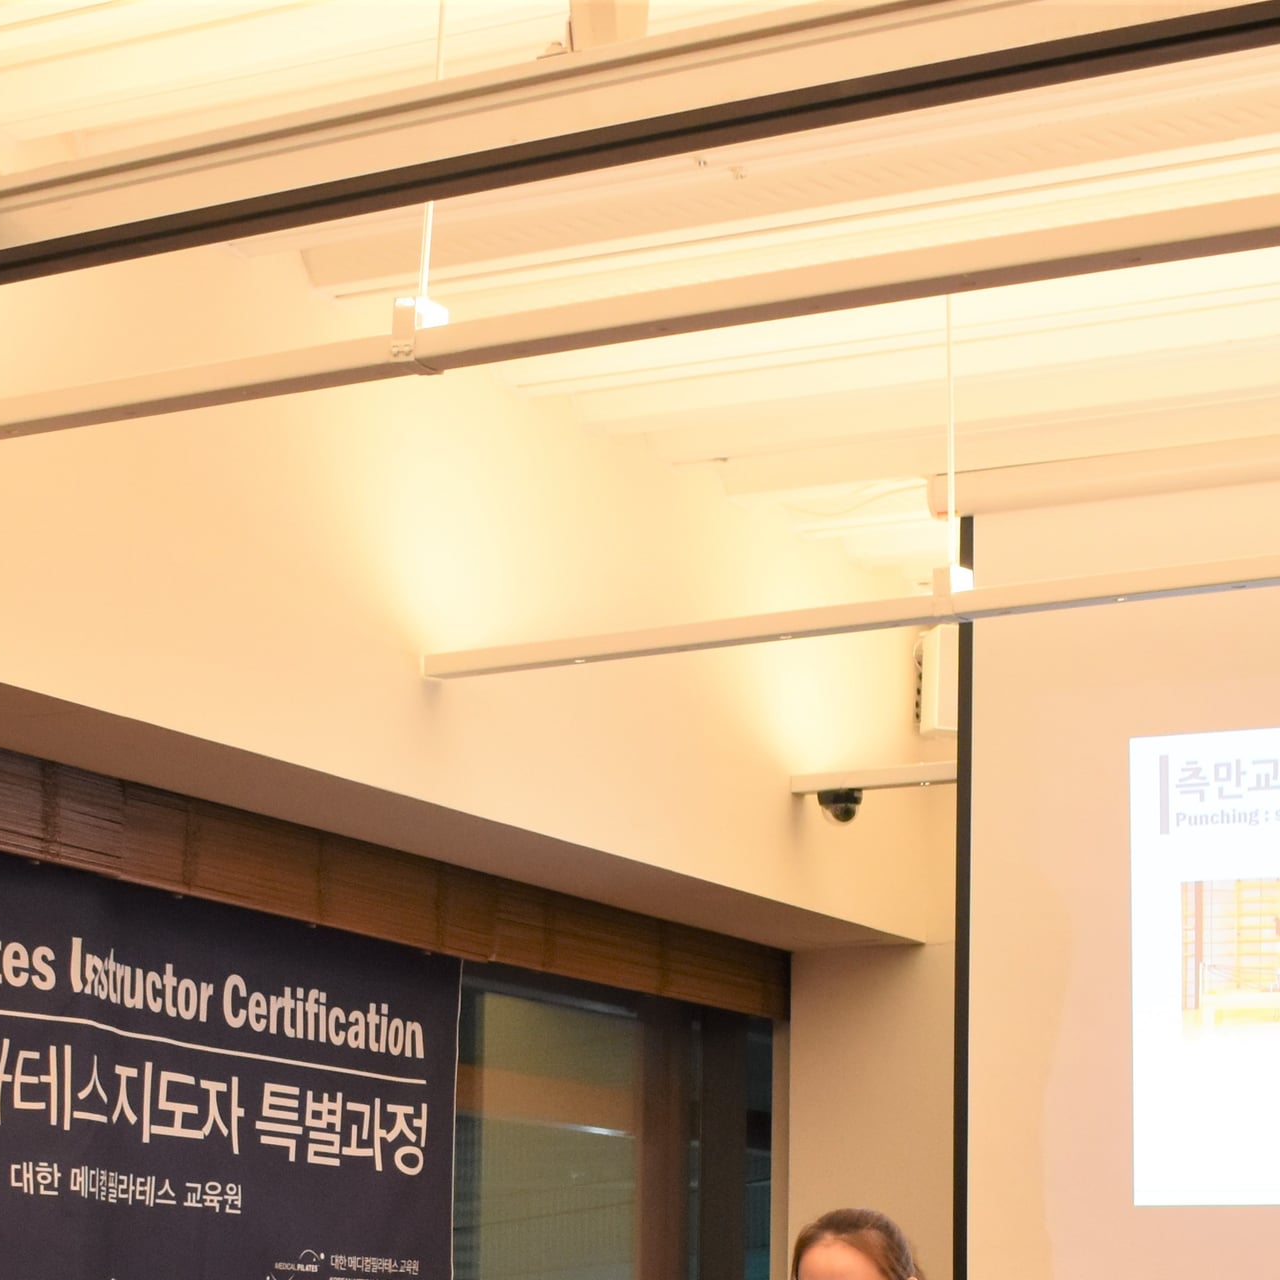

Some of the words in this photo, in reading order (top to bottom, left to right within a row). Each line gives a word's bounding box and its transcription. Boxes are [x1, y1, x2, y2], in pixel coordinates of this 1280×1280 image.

[1175, 809, 1260, 827] Punching
[223, 974, 425, 1059] Certification
[255, 1082, 428, 1176] 특별과정
[10, 1161, 62, 1196] 대한
[70, 1165, 177, 1207] 메디컬필라테스
[183, 1181, 242, 1214] 교육원
[274, 1262, 297, 1271] MEDICAL
[297, 1263, 318, 1272] PILATES
[330, 1255, 347, 1271] 대한
[399, 1260, 419, 1275] 교육원
